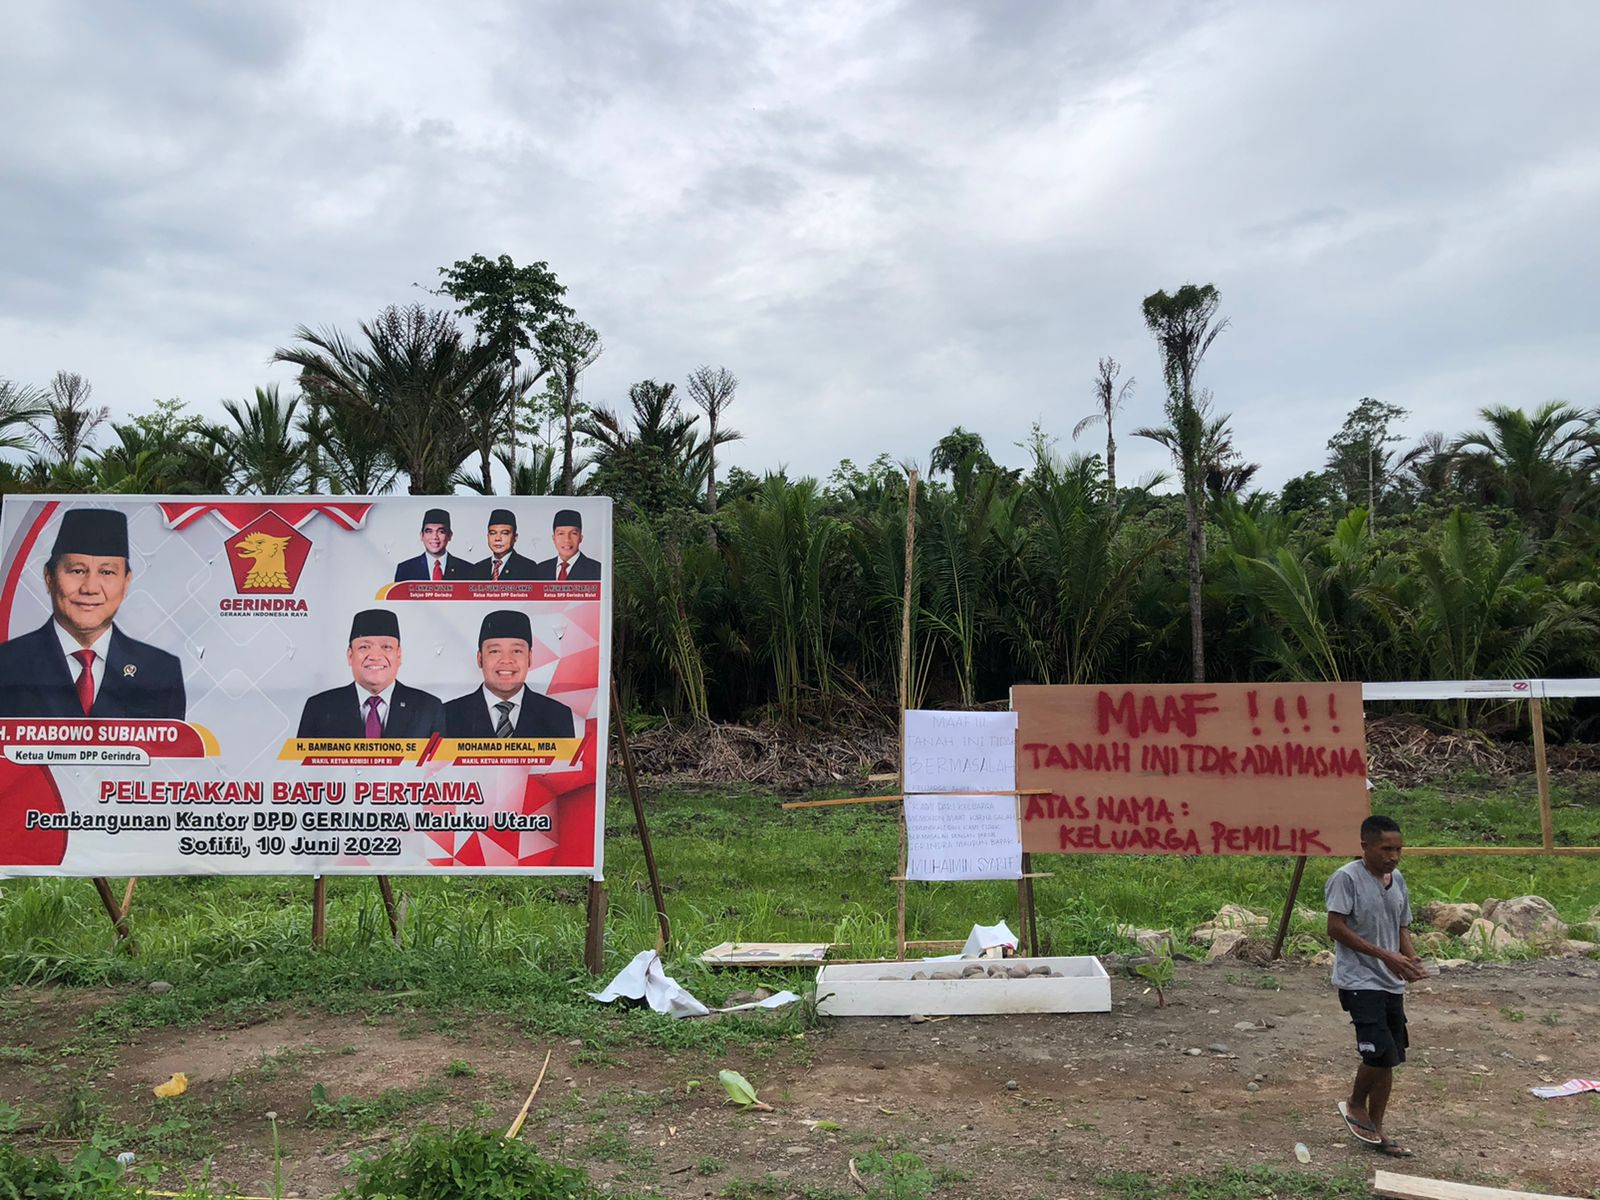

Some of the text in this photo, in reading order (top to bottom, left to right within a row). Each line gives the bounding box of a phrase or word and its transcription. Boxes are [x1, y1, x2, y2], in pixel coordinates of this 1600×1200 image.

[219, 598, 308, 611] GERINDRA
[1096, 690, 1342, 738] MAAF !!!!
[16, 726, 93, 741] PRABOWO
[98, 727, 178, 742] SUBIANTO
[906, 736, 954, 746] TANAH
[963, 736, 985, 747] INI
[15, 751, 141, 761] Ketua Umum DPP Gerindra
[297, 742, 416, 752] H. BAMBANG KRISTIONO, SE
[458, 742, 556, 752] MOHAMAD HEKAL, MBA
[1022, 742, 1131, 773] TANAH
[1141, 745, 1179, 776] INI
[1180, 743, 1238, 776] TDK
[99, 780, 484, 804] PELETAKAN BATU PERTAMA
[1024, 795, 1090, 822] ATAS
[26, 810, 552, 833] Pembangunan Kantor DPD GERINDRA Maluku Utara
[179, 836, 402, 857] Sofifi, 10 Juni 2022
[1059, 820, 1332, 853] KELUARGA PEMILIK
